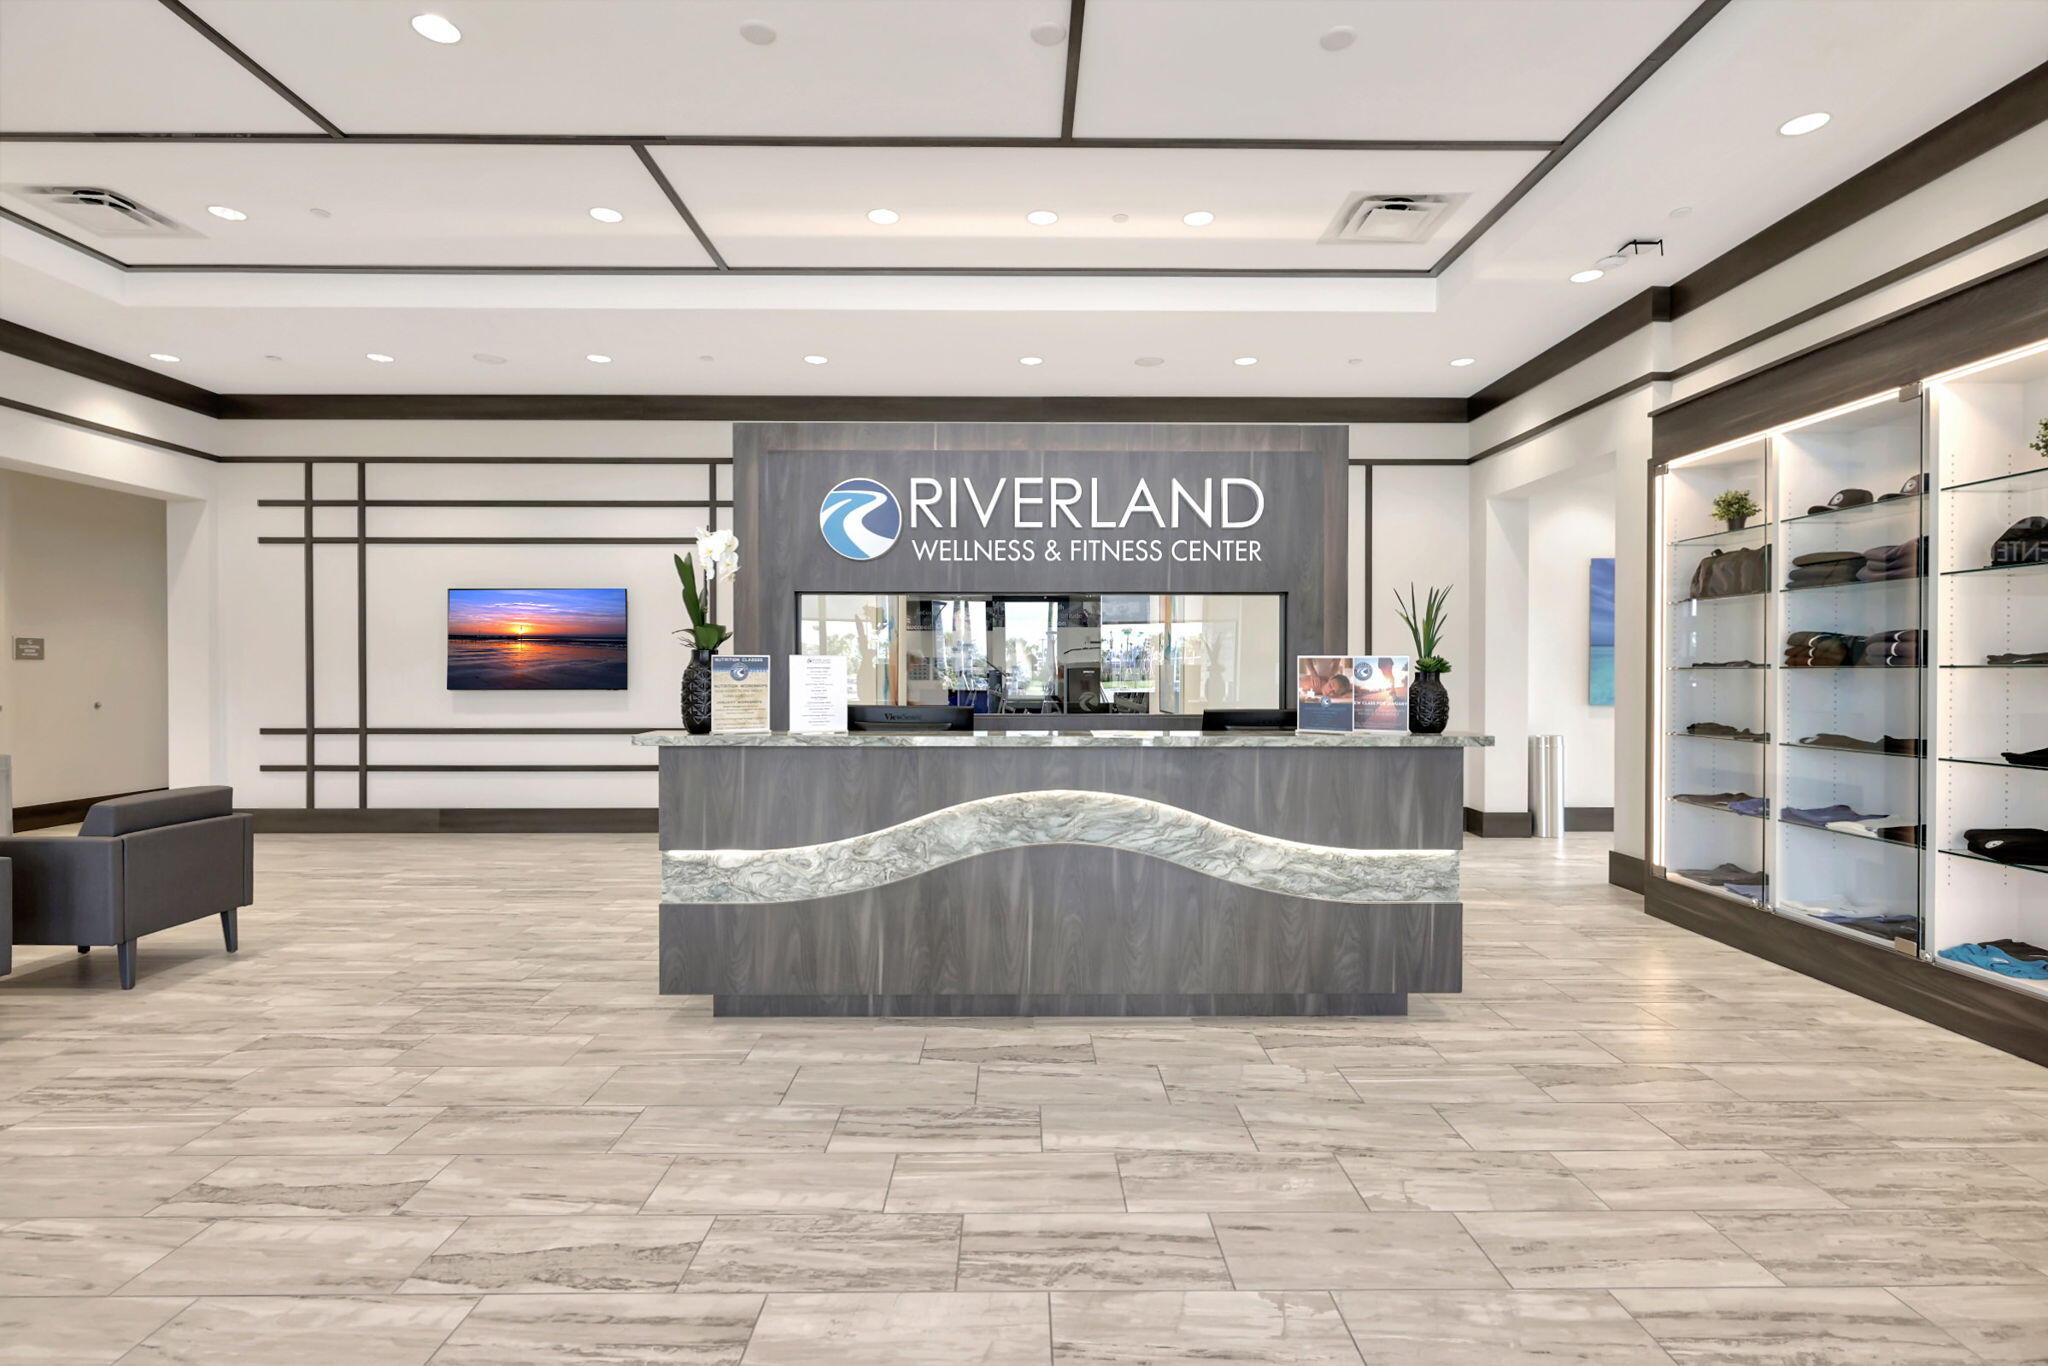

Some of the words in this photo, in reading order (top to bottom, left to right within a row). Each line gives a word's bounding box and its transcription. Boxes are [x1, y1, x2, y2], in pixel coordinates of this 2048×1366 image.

[909, 477, 1265, 529] RIVERLAND
[912, 539, 1036, 562] WELLNESS
[1044, 539, 1062, 562] &
[1070, 539, 1163, 562] FITNESS
[1171, 539, 1263, 562] CENTER
